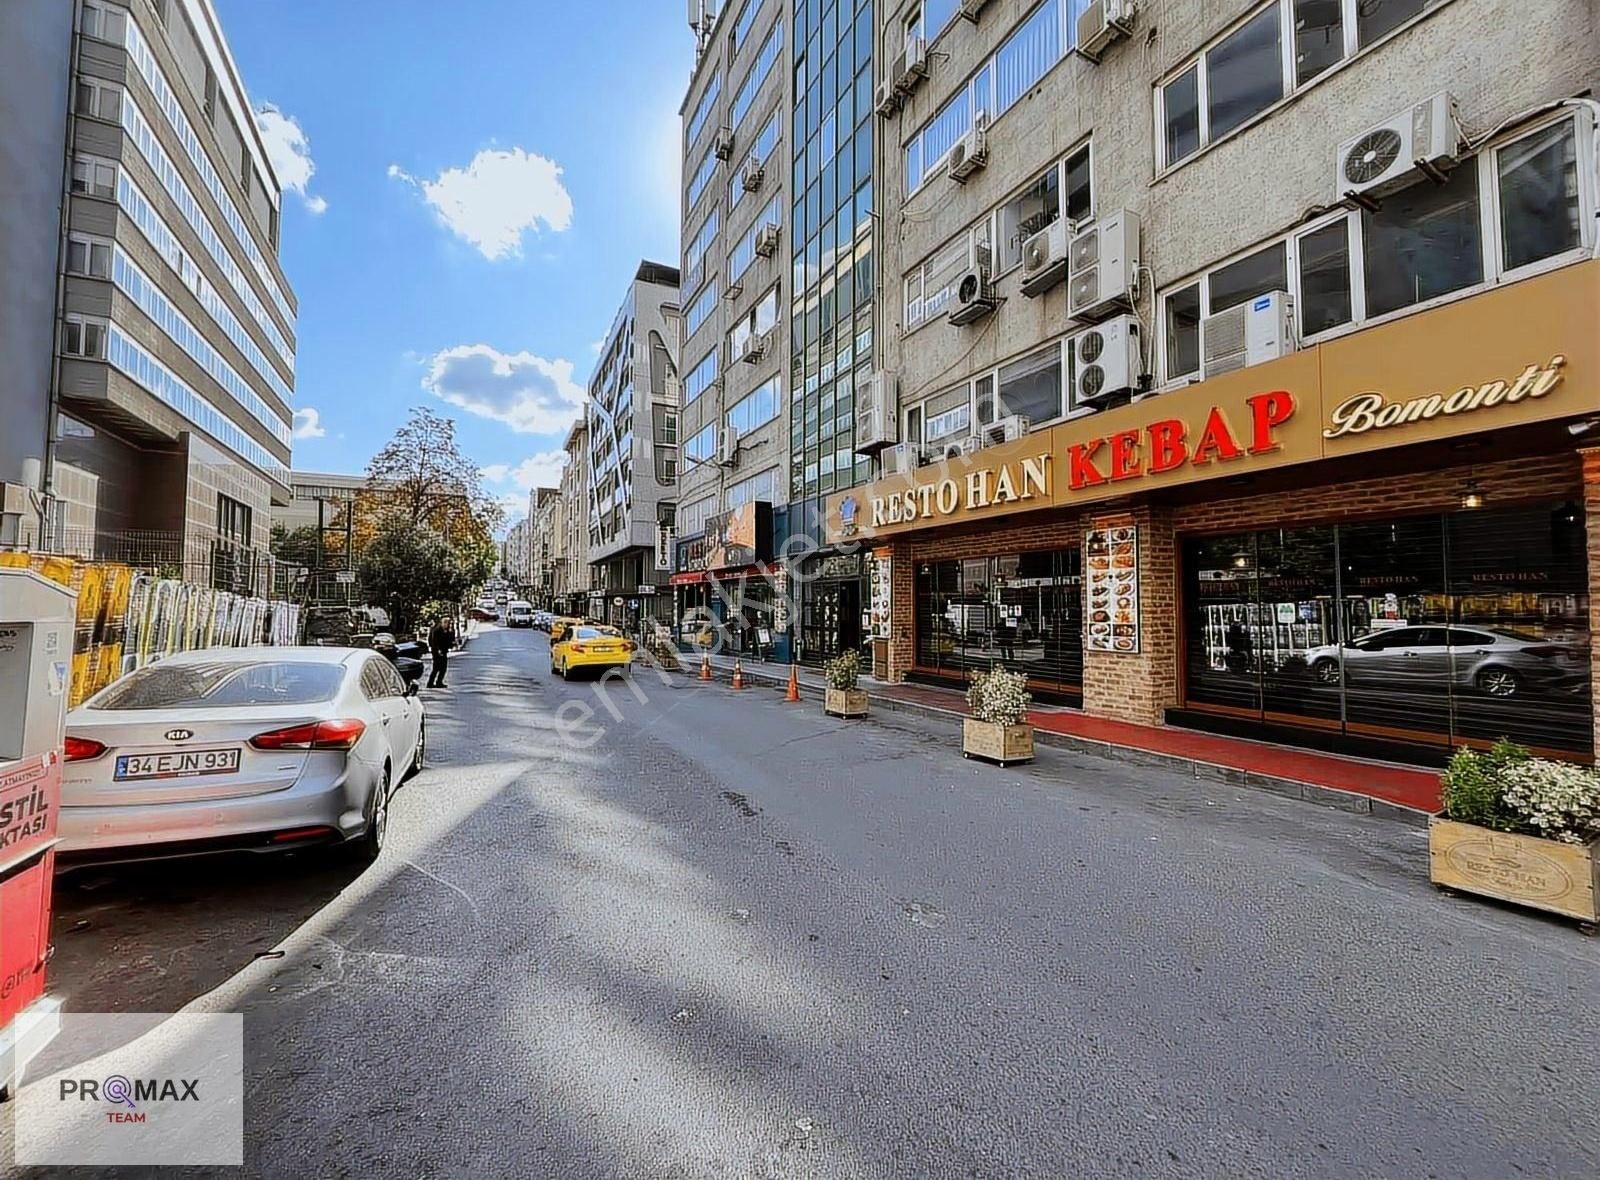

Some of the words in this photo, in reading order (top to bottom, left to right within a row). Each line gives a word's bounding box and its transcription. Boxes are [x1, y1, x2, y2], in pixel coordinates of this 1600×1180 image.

[1067, 388, 1298, 491] KEBAP
[1322, 354, 1568, 440] Bomonti
[128, 757, 152, 774] 34
[156, 754, 200, 772] EJN
[204, 751, 236, 768] 931
